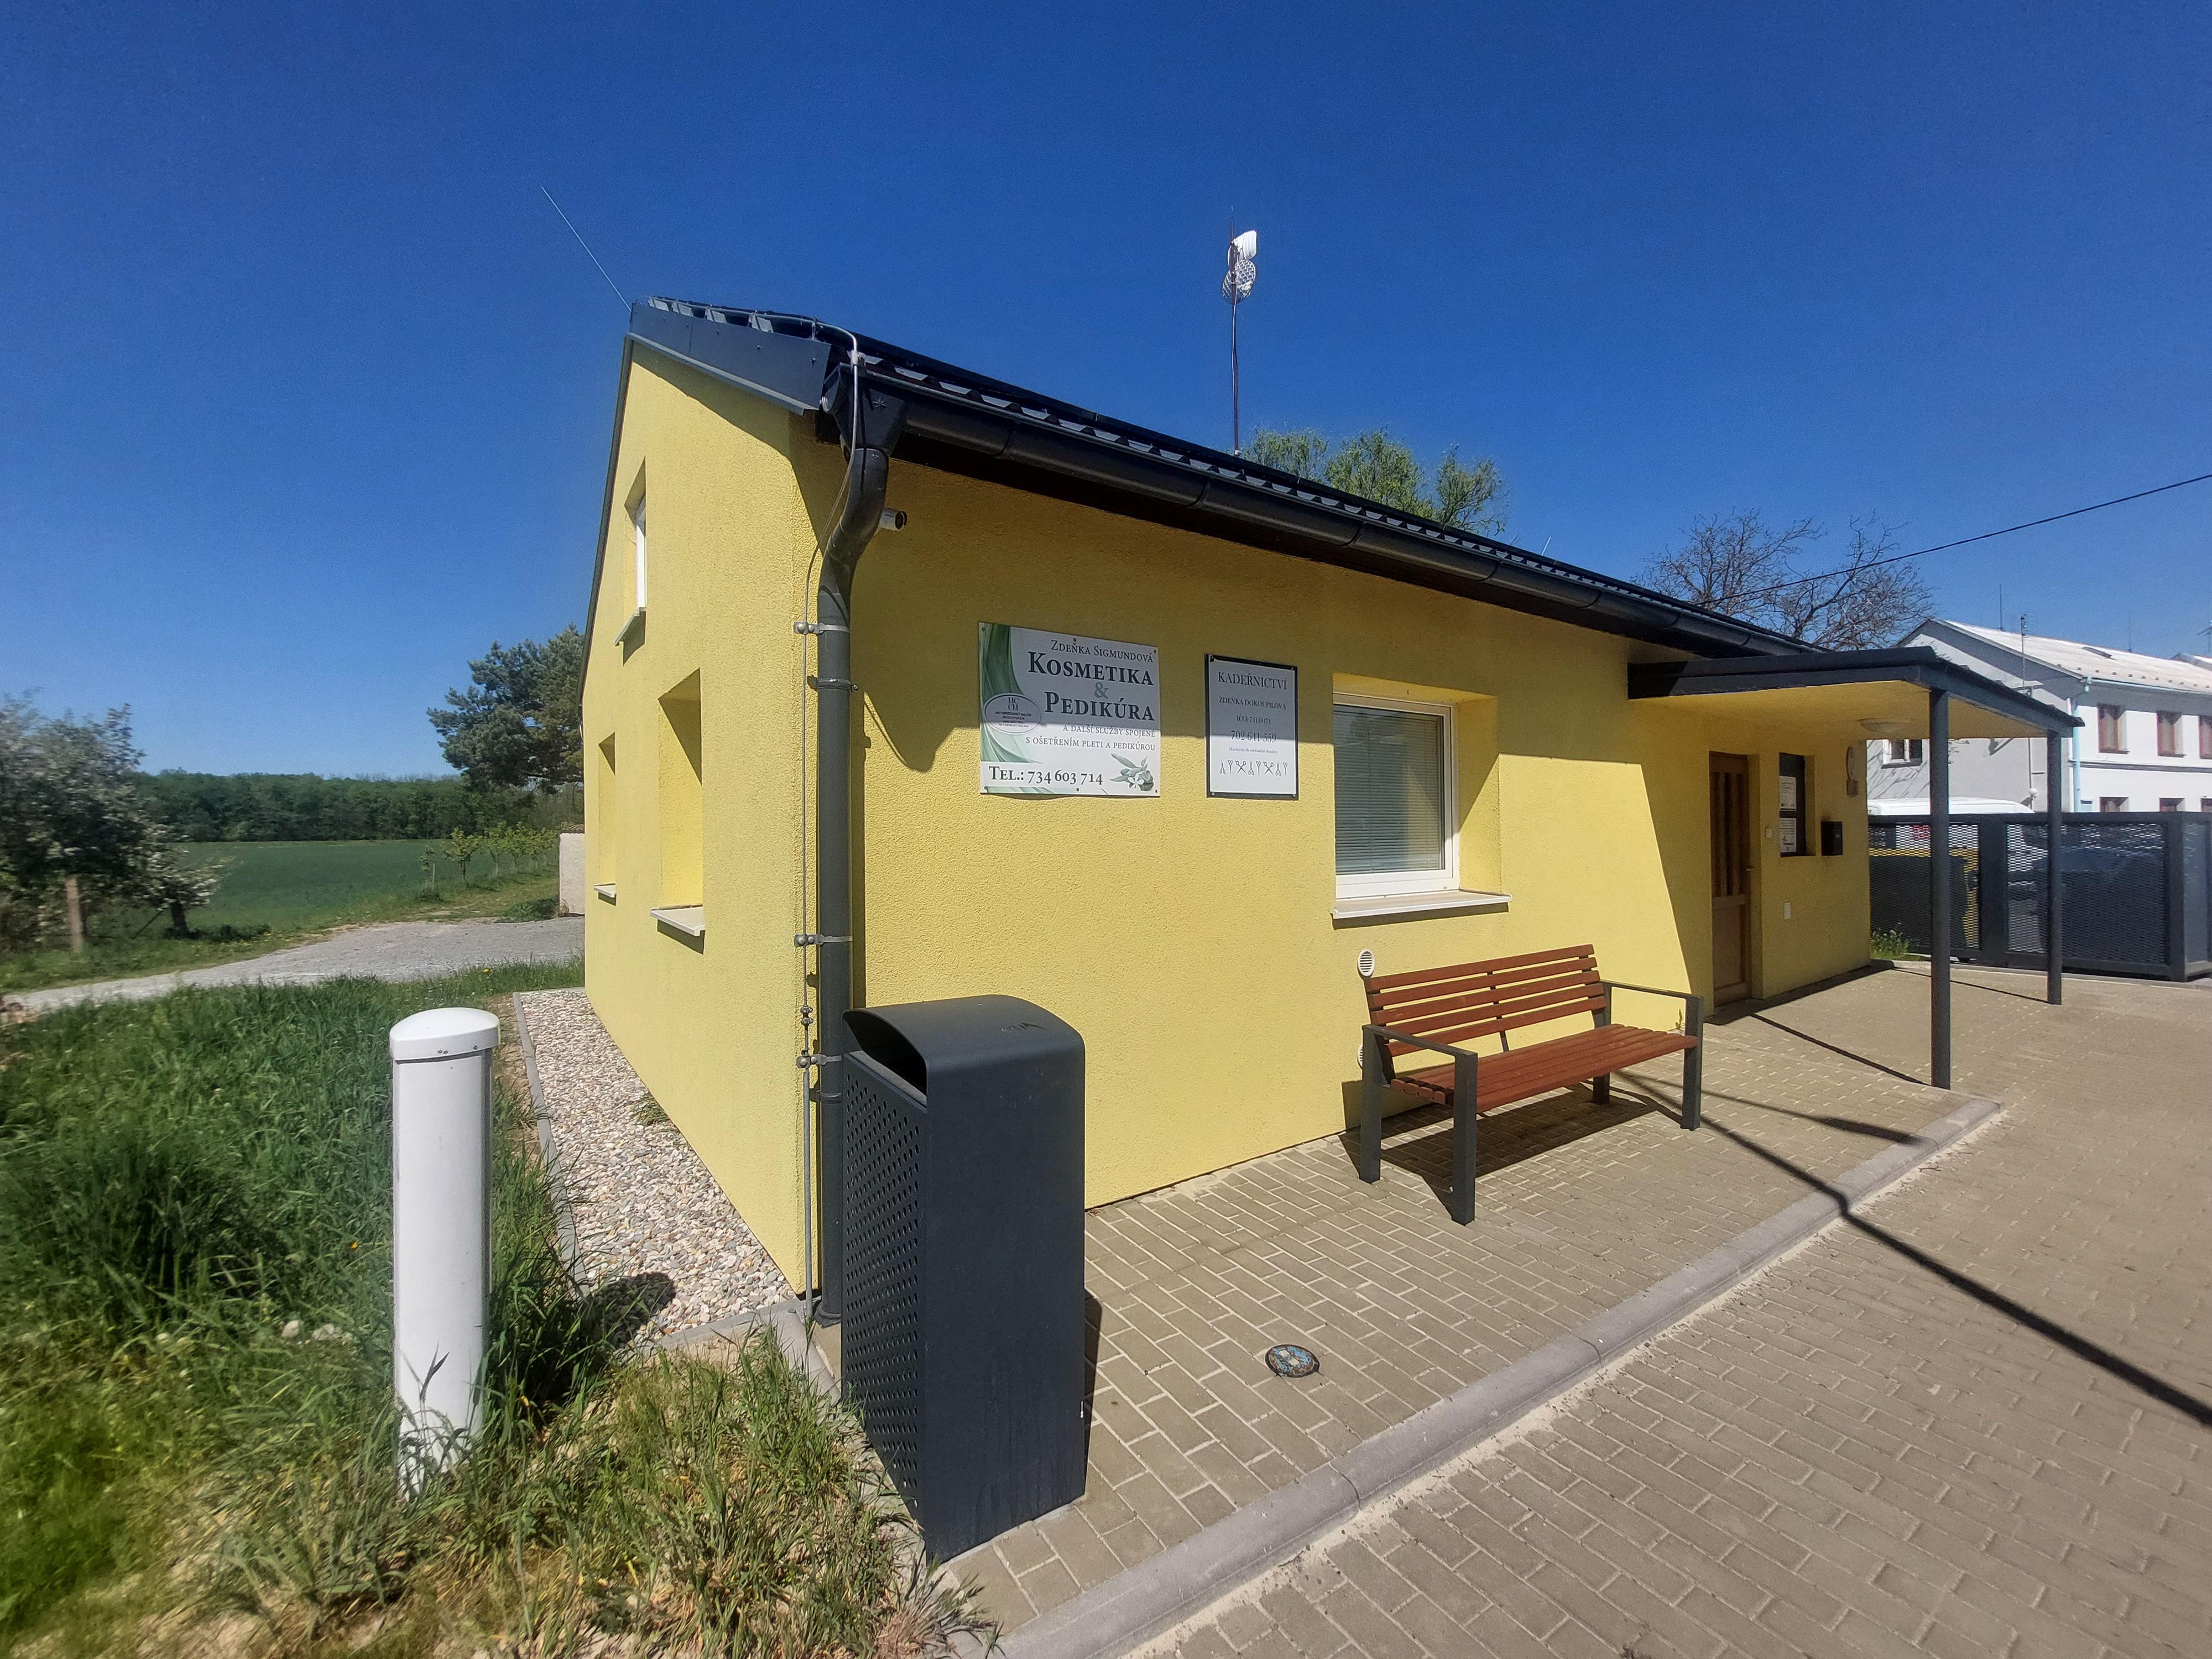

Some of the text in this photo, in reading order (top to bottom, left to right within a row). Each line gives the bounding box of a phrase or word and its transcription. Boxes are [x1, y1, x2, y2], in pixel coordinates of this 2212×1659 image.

[1094, 645, 1154, 663] SIGMUNDOVÁ
[1027, 651, 1154, 686] KOSMETIKA
[1218, 671, 1287, 691] KADEŘNICTVÍ
[1094, 682, 1109, 699] &
[1044, 691, 1155, 721] PEDIKÚRA
[1219, 696, 1244, 705] ZDEŇKA
[1071, 724, 1093, 733] DALŠÍ
[1095, 726, 1124, 735] SLUŽBY
[1125, 729, 1155, 738] SPOJENÉ
[1231, 730, 1245, 740] 702
[1262, 733, 1276, 743] 559
[1032, 735, 1079, 747] OŠETŘENÍM
[1082, 740, 1103, 748] PLETI
[1113, 741, 1155, 751] PEDIKÚROU
[1027, 771, 1051, 784] 734
[1055, 769, 1076, 785] 603
[1080, 773, 1103, 786] 714
